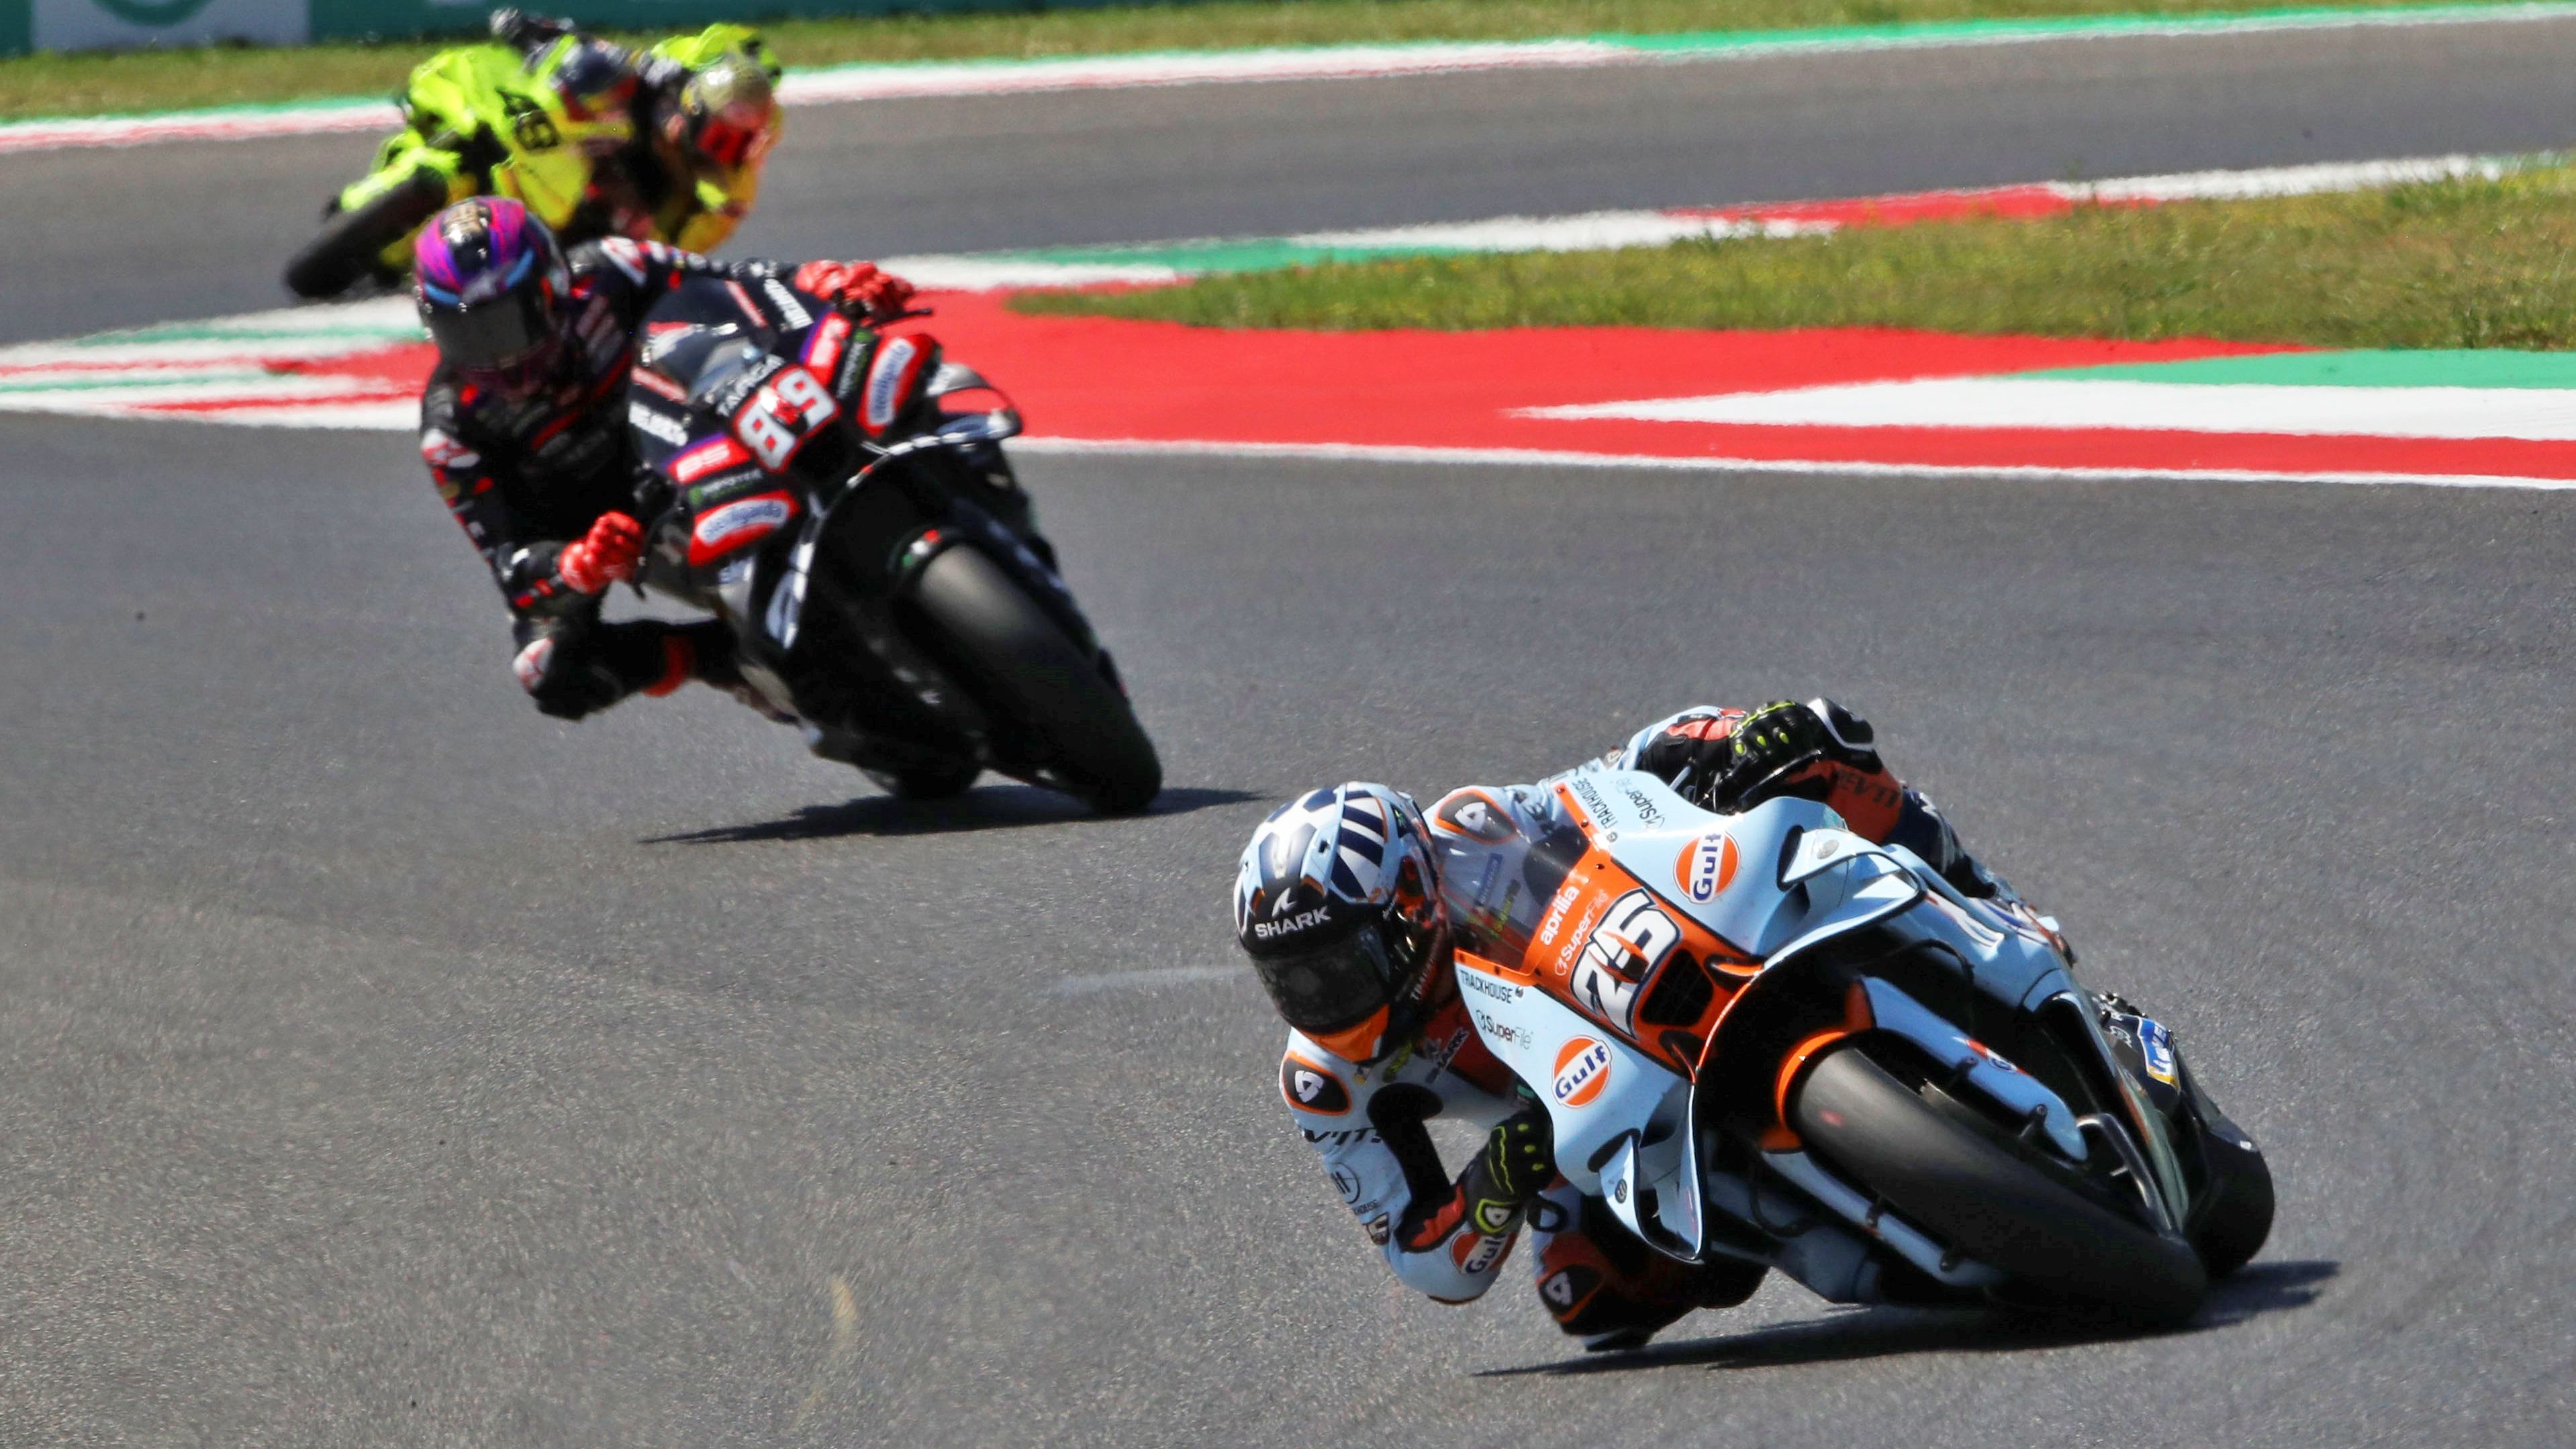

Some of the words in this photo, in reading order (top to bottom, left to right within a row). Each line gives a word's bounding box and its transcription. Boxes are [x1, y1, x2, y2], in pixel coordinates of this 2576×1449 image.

[736, 368, 838, 470] 89
[1572, 777, 1619, 830] TRACKHOUSE
[1692, 833, 1721, 901] Gulf
[1254, 905, 1332, 938] SHARK
[1540, 885, 1581, 946] aprilia
[1459, 969, 1513, 1004] TRACKHOUSE
[1571, 887, 1682, 1040] 25
[1555, 1045, 1607, 1099] Gulf
[1466, 1234, 1506, 1273] Gul
